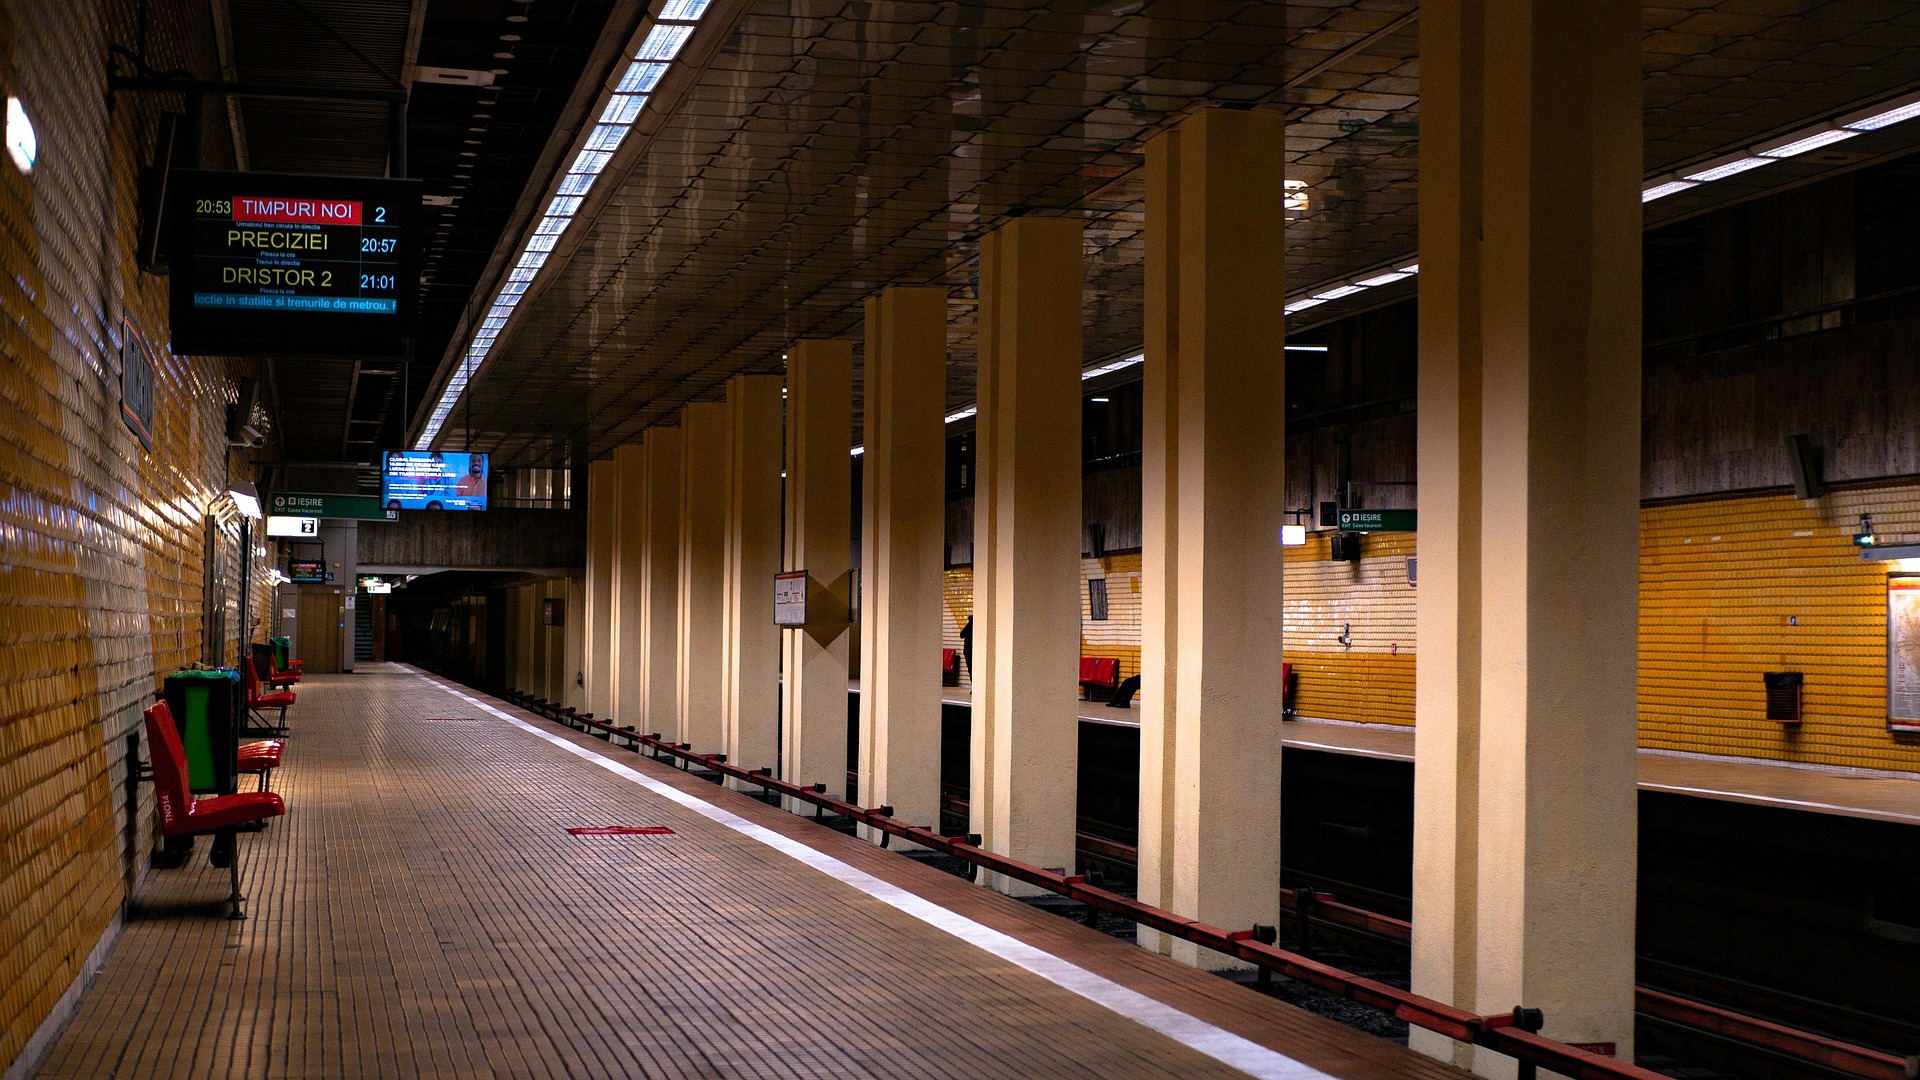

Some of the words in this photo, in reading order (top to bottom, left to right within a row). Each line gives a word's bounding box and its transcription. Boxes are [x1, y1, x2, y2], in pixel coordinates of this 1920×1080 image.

[196, 199, 231, 214] 20:53
[242, 200, 315, 217] TIMPURI
[321, 203, 352, 219] NOI
[374, 206, 386, 223] 2
[227, 230, 328, 250] PRECIZIEI
[361, 237, 397, 253] 20:57
[223, 266, 315, 287] DRISTOR
[320, 270, 332, 287] 2
[360, 274, 395, 290] 21:01
[226, 295, 235, 305] in
[238, 295, 273, 306] statiile
[275, 296, 285, 307] si
[287, 297, 330, 309] trenurile
[333, 299, 347, 309] de
[349, 300, 389, 310] metrou.
